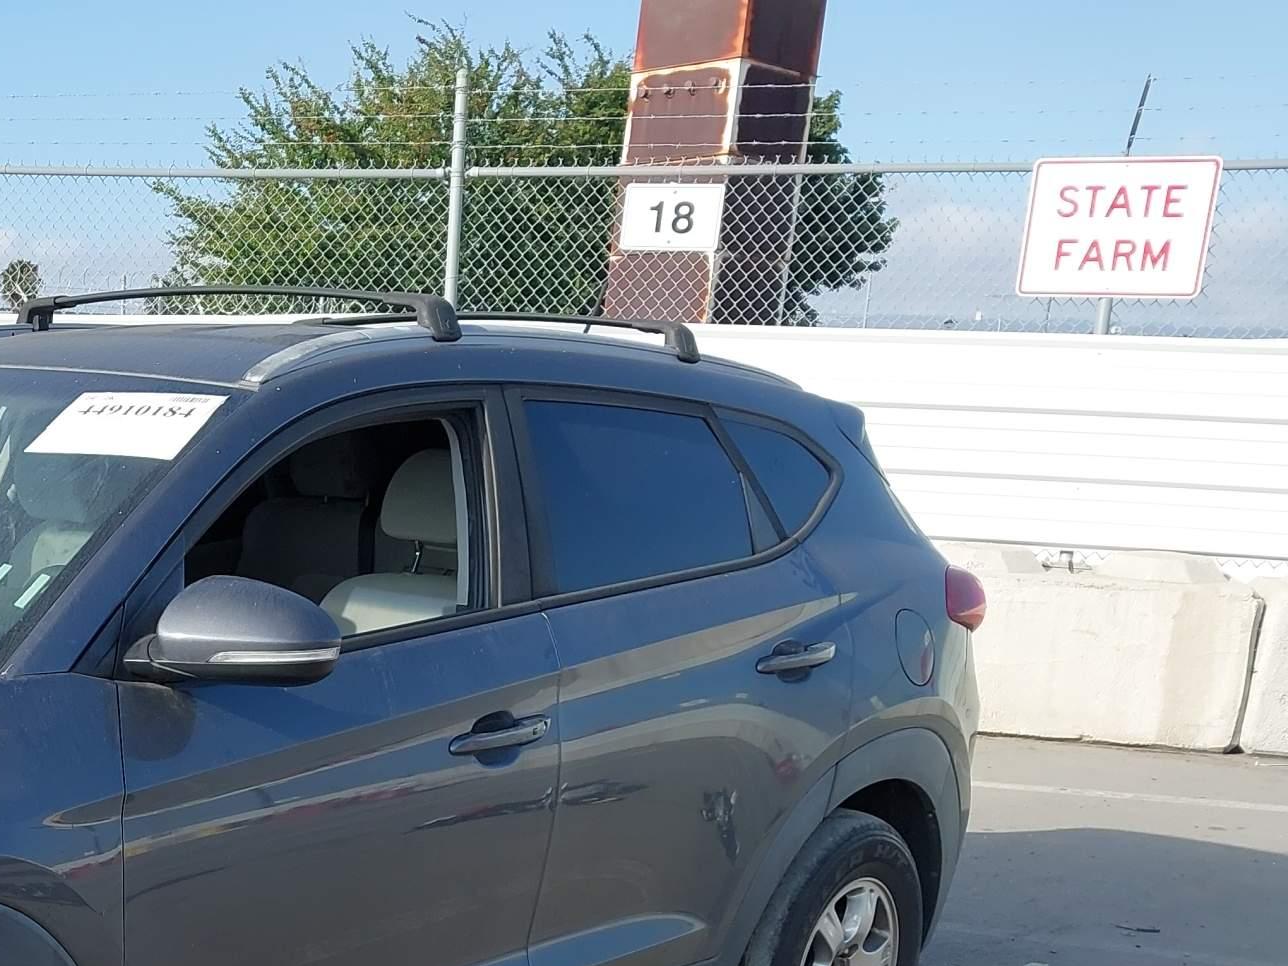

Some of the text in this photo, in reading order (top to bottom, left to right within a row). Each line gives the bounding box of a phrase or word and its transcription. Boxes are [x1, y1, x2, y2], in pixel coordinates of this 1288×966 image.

[650, 201, 695, 234] 18
[1057, 185, 1188, 218] STATE
[1054, 239, 1171, 271] FARM
[78, 404, 196, 418] 44910184
